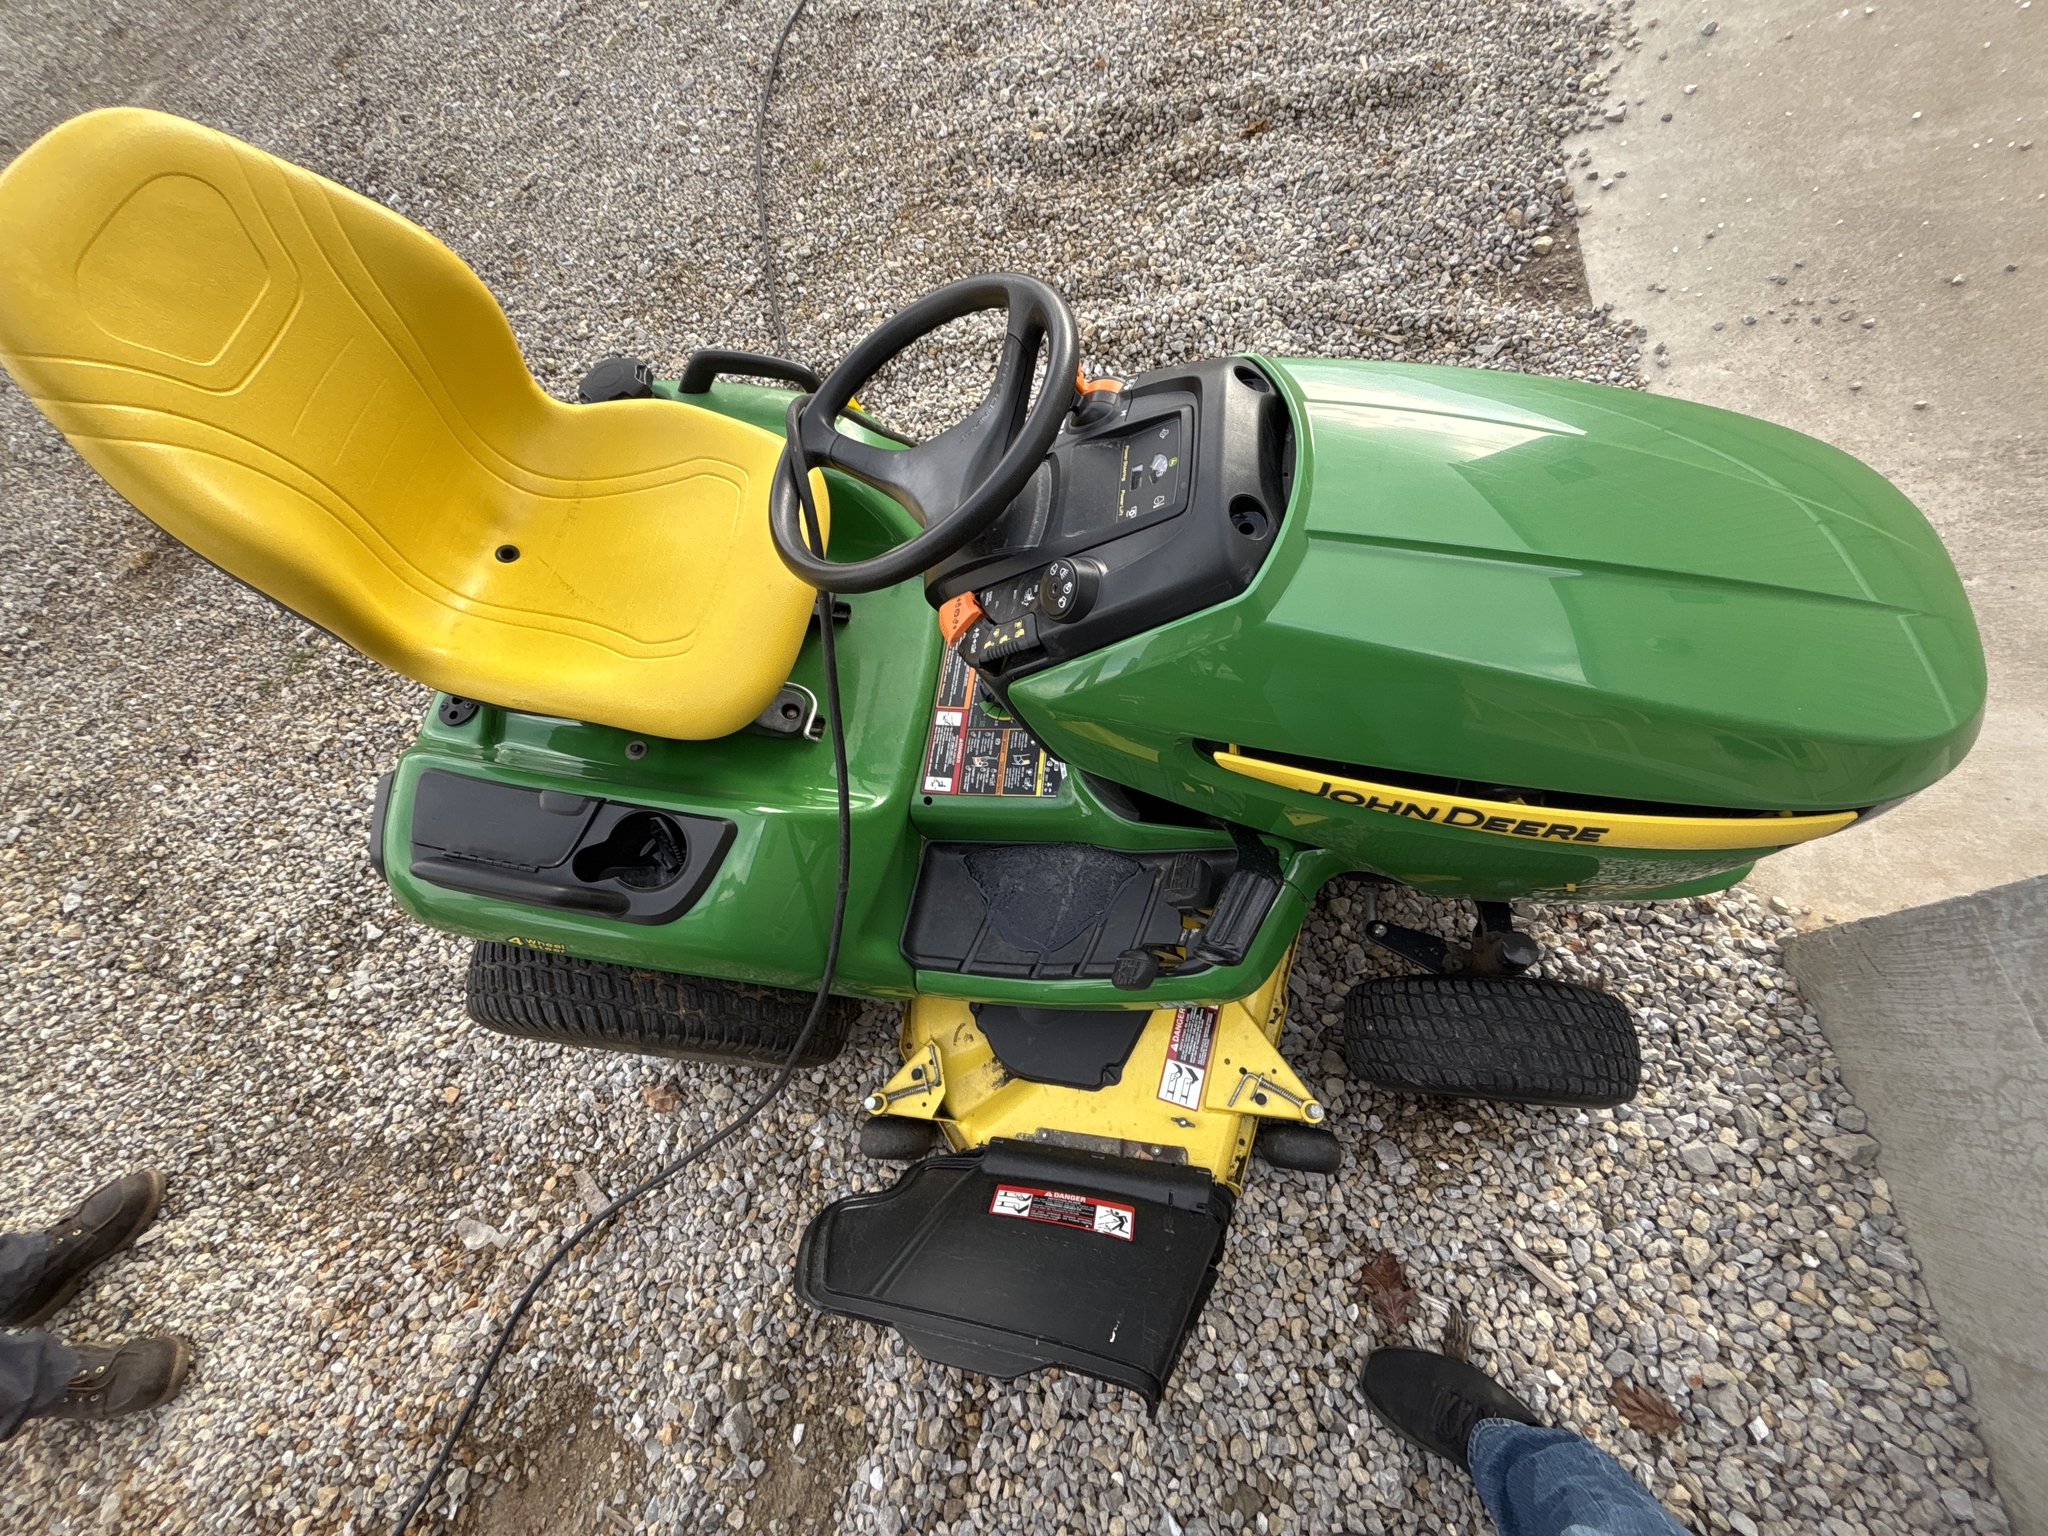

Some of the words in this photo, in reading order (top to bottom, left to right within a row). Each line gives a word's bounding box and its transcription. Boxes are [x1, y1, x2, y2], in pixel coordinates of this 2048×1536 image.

[1121, 460, 1129, 482] Steering
[1298, 781, 1439, 820] JOHN
[1442, 805, 1610, 842] DEERE
[508, 936, 524, 946] 4
[525, 938, 565, 949] Wheel
[1171, 1007, 1187, 1043] DANGER
[1053, 1191, 1087, 1203] DANGER
